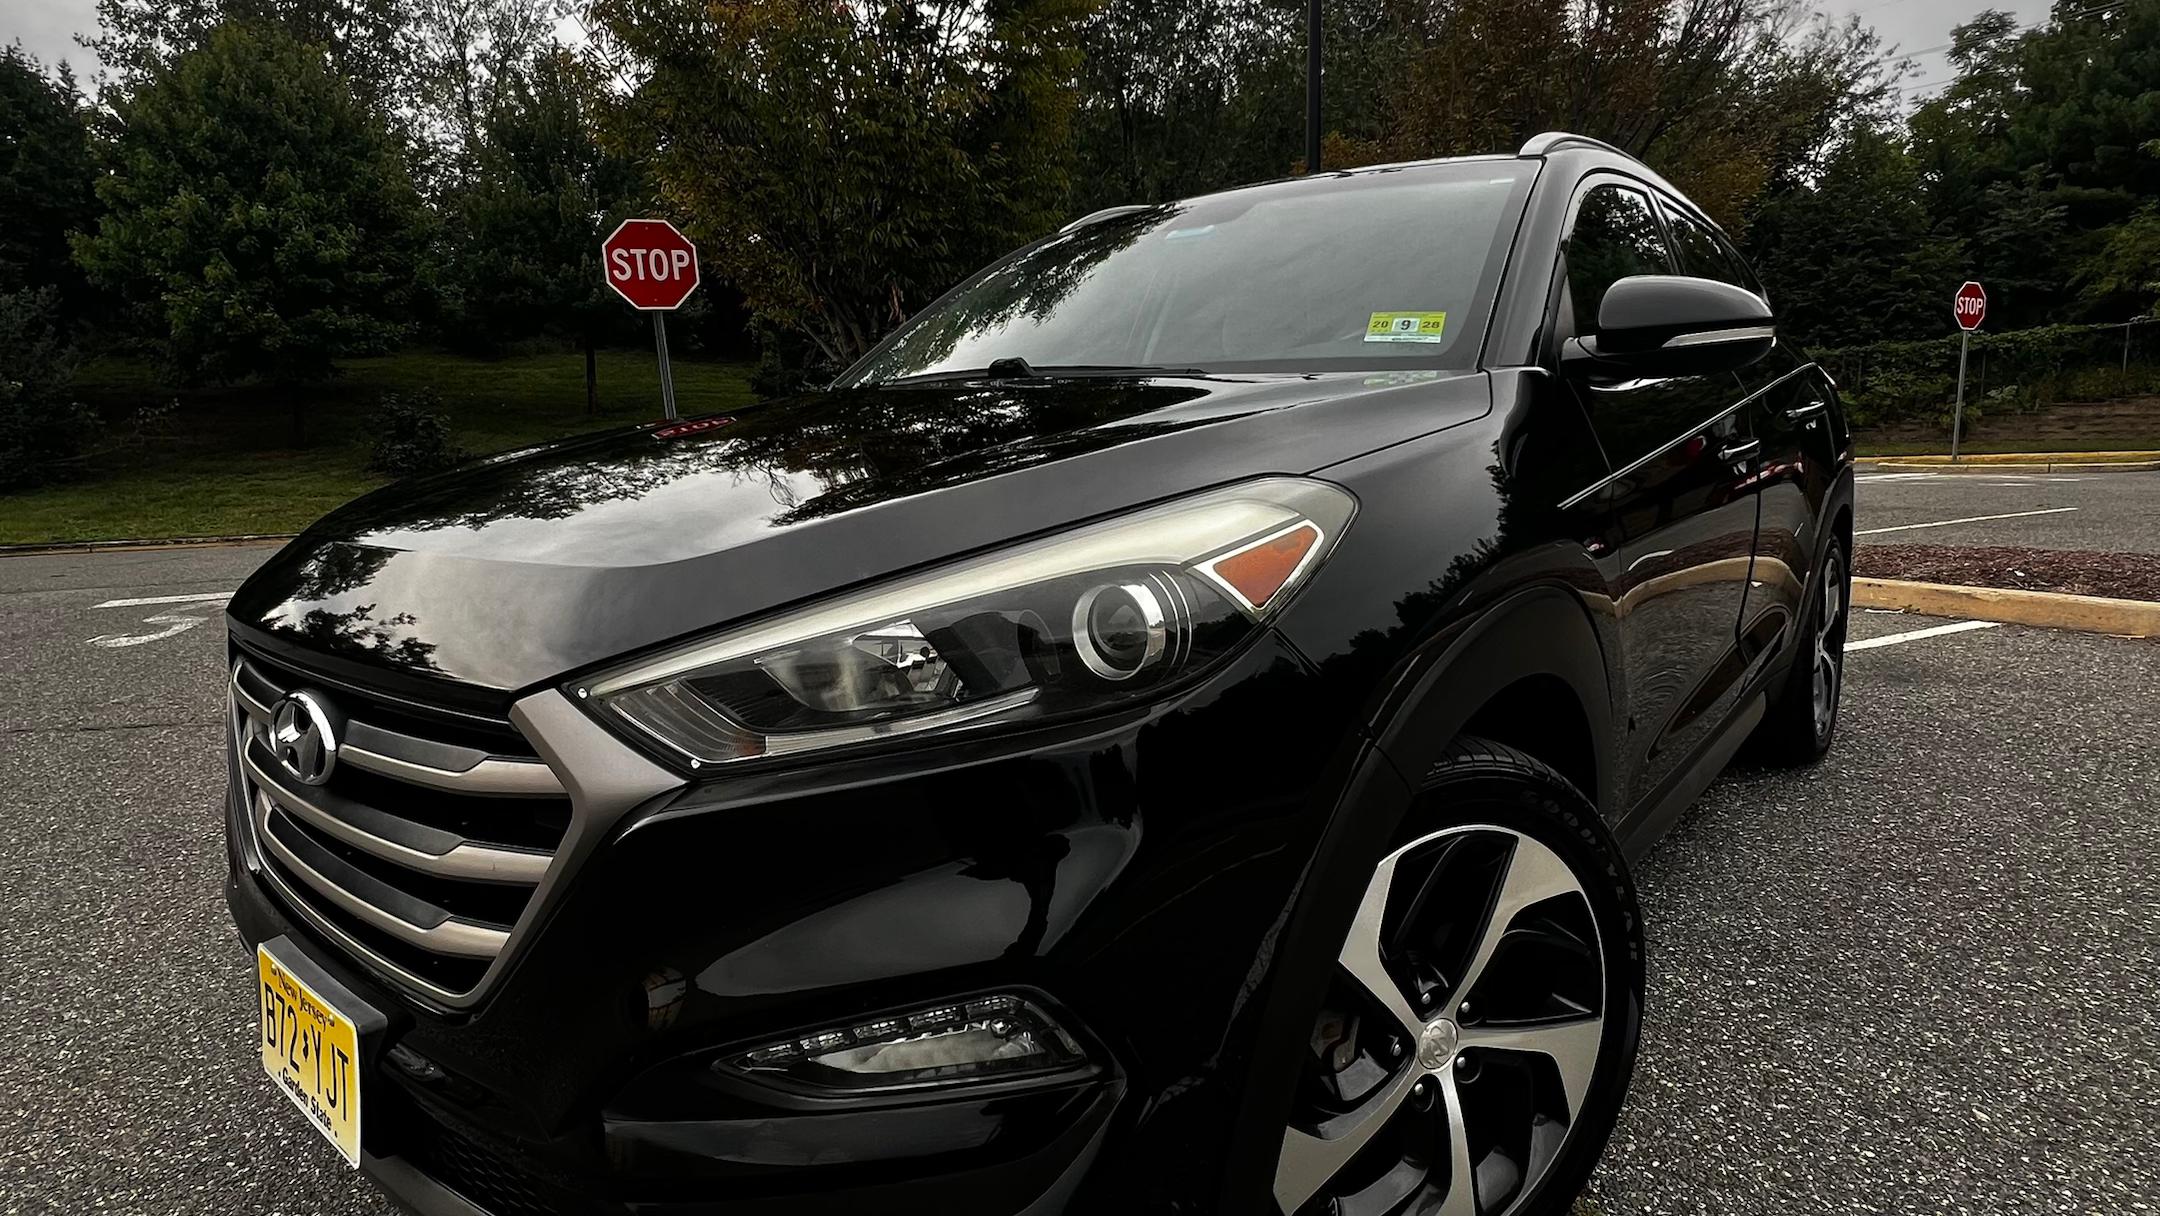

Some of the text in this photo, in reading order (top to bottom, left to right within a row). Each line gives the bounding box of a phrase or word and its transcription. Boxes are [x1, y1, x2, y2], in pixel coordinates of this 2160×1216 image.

[612, 248, 690, 281] STOP
[1957, 296, 1983, 315] STOP
[1372, 320, 1389, 329] 20
[1400, 319, 1411, 331] 9
[277, 967, 327, 1032] New Jersey
[283, 1067, 332, 1131] Garden State
